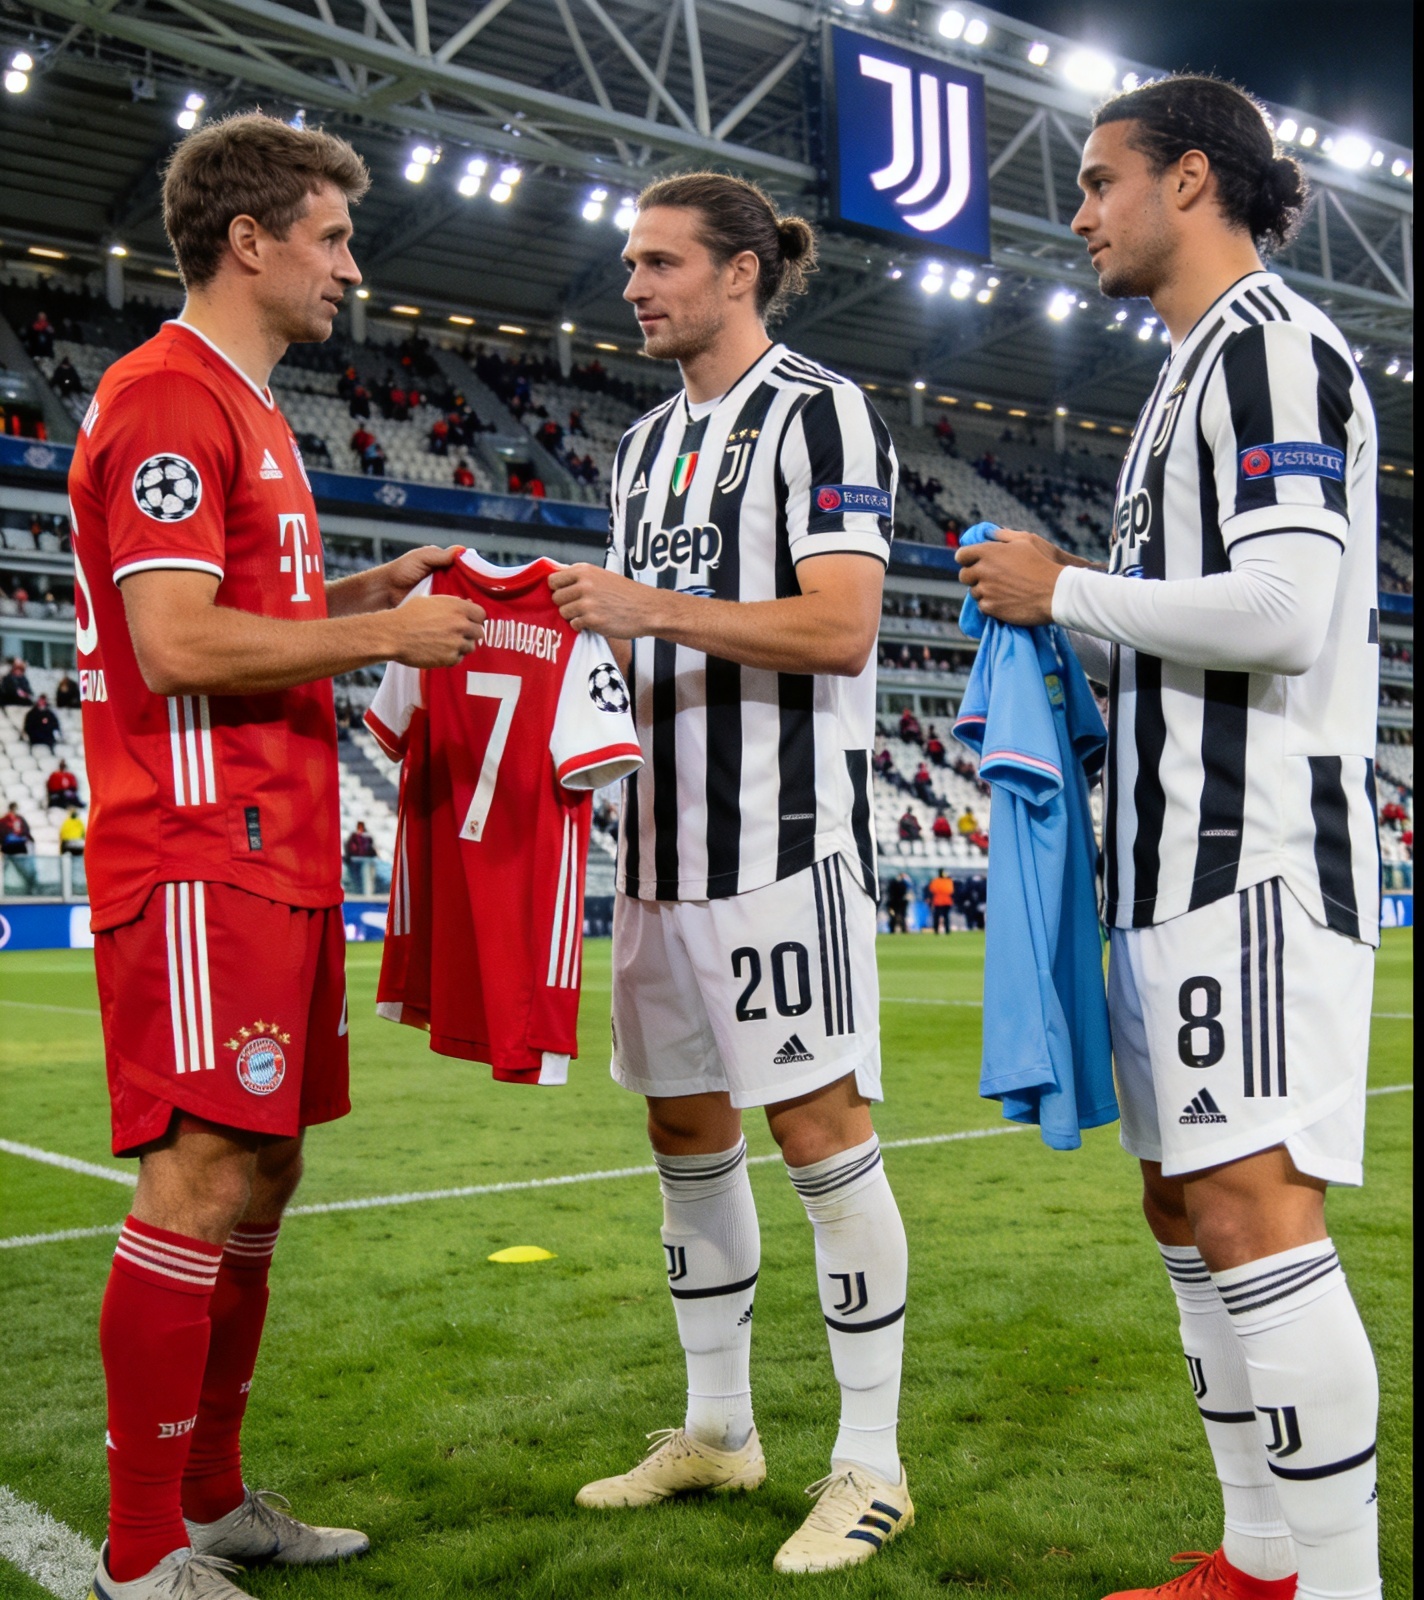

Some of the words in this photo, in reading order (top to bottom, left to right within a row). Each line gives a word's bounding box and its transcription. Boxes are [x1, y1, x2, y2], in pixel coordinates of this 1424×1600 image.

[629, 521, 722, 575] Jeep
[458, 670, 523, 843] 7
[730, 941, 813, 1023] 20
[1177, 975, 1226, 1069] 8
